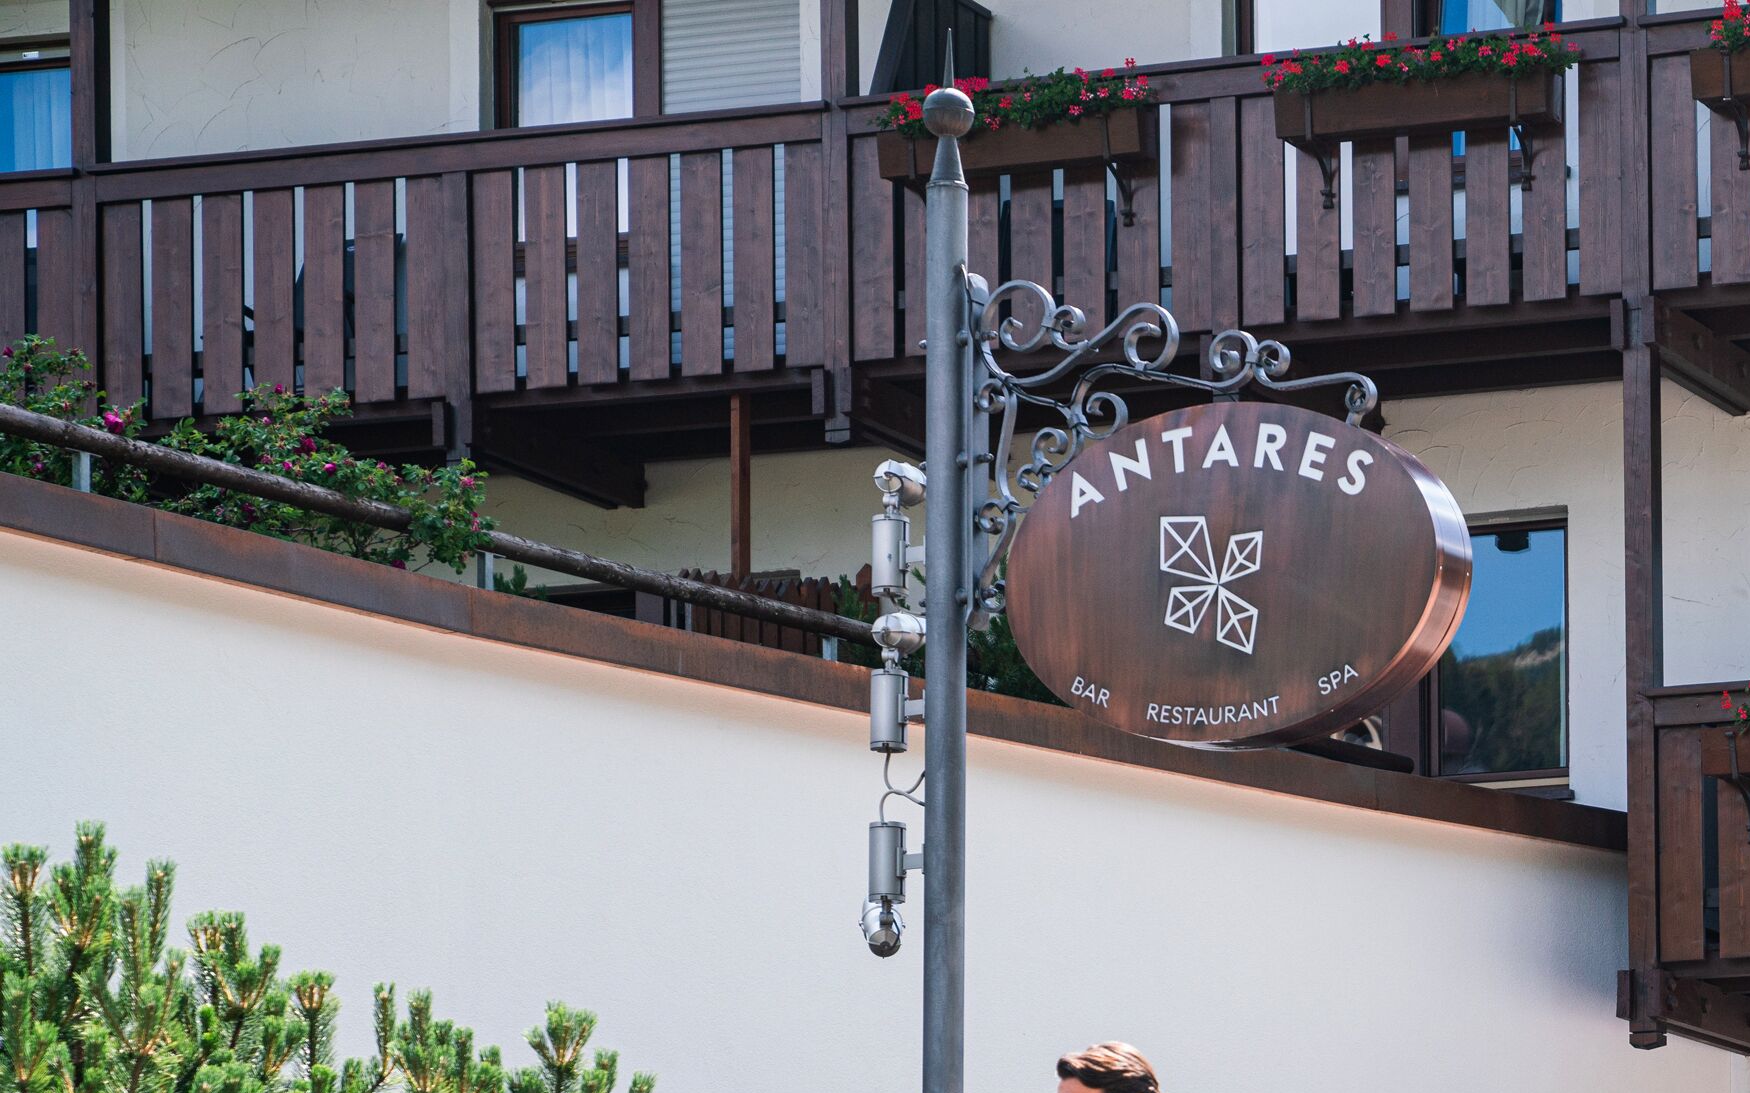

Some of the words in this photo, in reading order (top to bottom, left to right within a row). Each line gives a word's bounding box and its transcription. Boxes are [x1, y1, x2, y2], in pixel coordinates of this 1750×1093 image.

[1069, 422, 1374, 519] ANTARES
[1070, 675, 1110, 709] BAR
[1146, 694, 1280, 726] RESTAURANT
[1317, 663, 1359, 696] SPA
